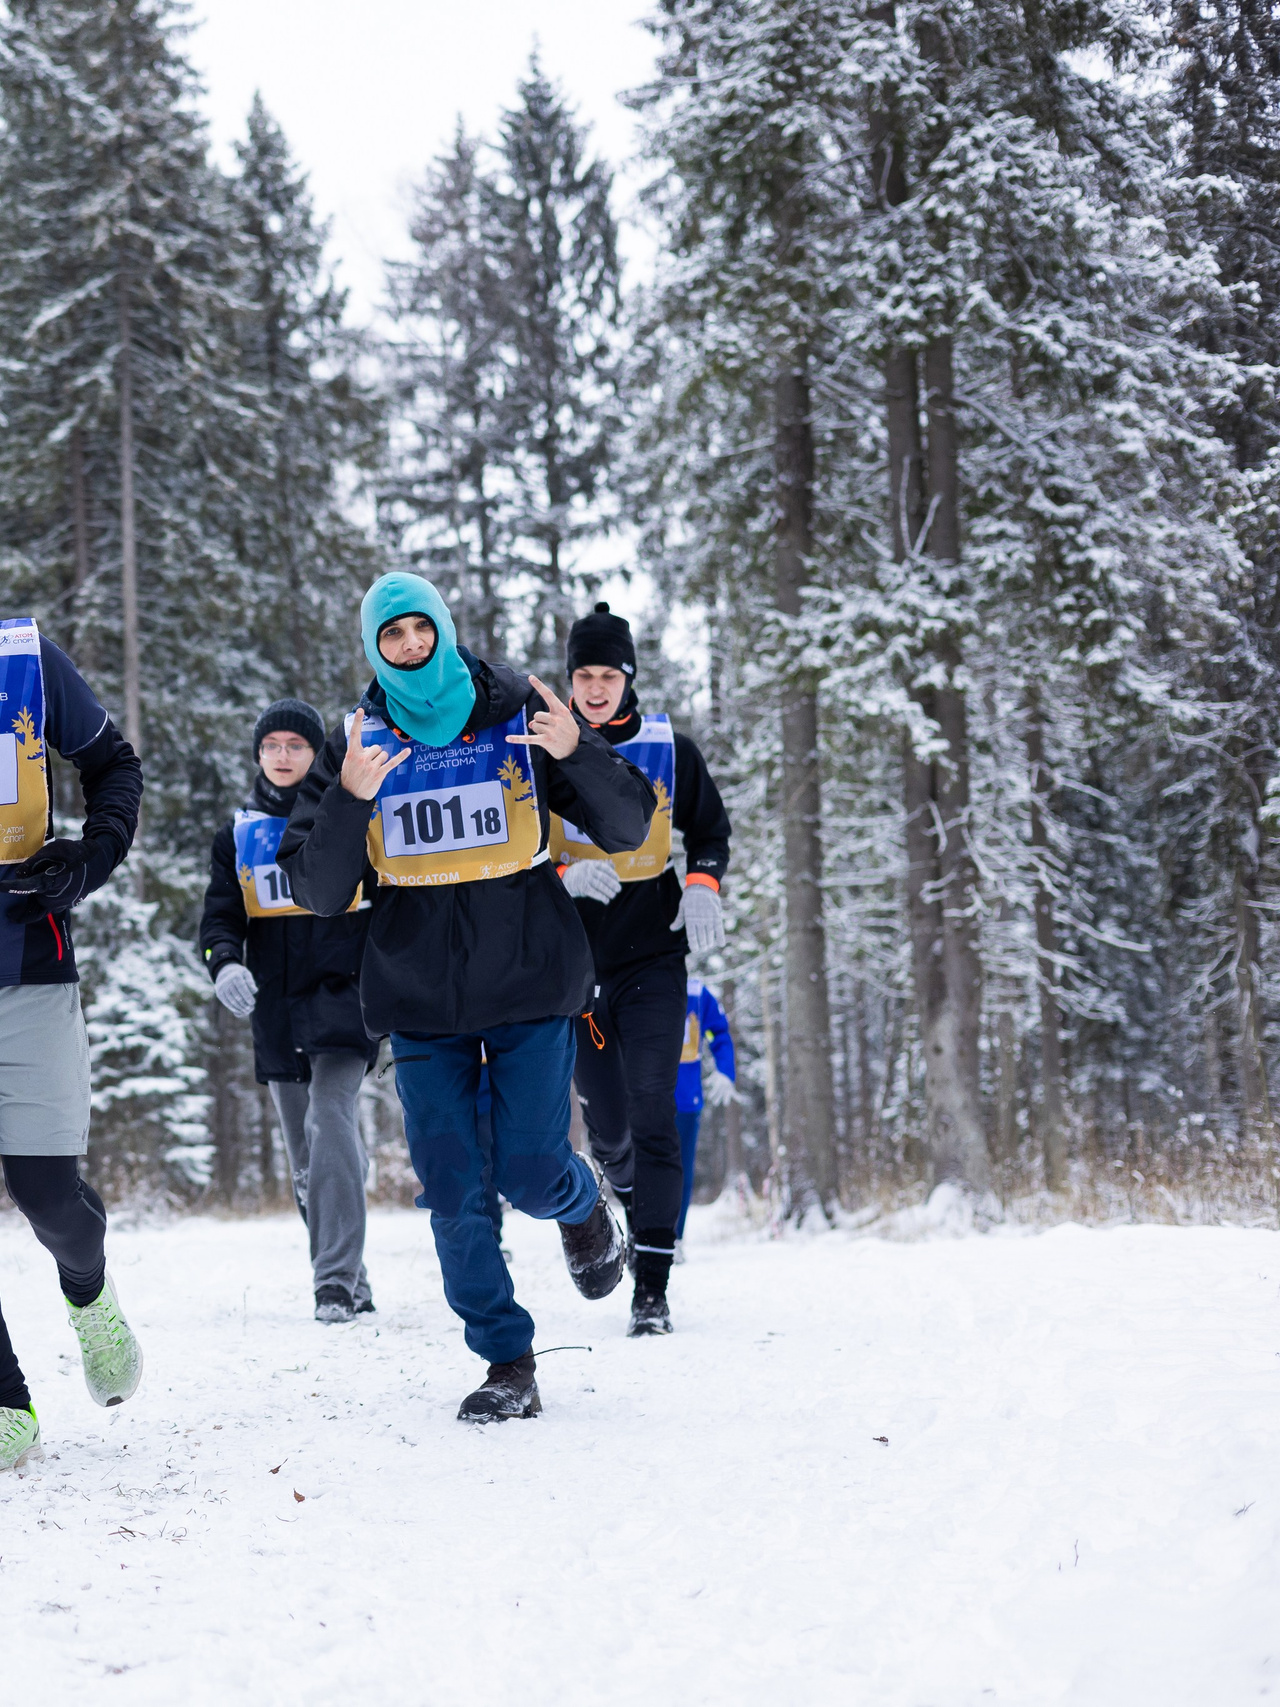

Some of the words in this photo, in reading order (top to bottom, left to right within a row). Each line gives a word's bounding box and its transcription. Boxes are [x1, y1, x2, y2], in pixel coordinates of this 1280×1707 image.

[414, 743, 495, 764] ДИВИЗИОНОВ
[415, 756, 477, 773] РОСАТОМА
[393, 795, 465, 846] 101
[470, 807, 502, 837] 18
[6, 825, 24, 834] АТОМ
[3, 834, 25, 844] СПОРТ
[497, 860, 519, 871] АТОМ
[399, 871, 460, 885] РОСАТОМ
